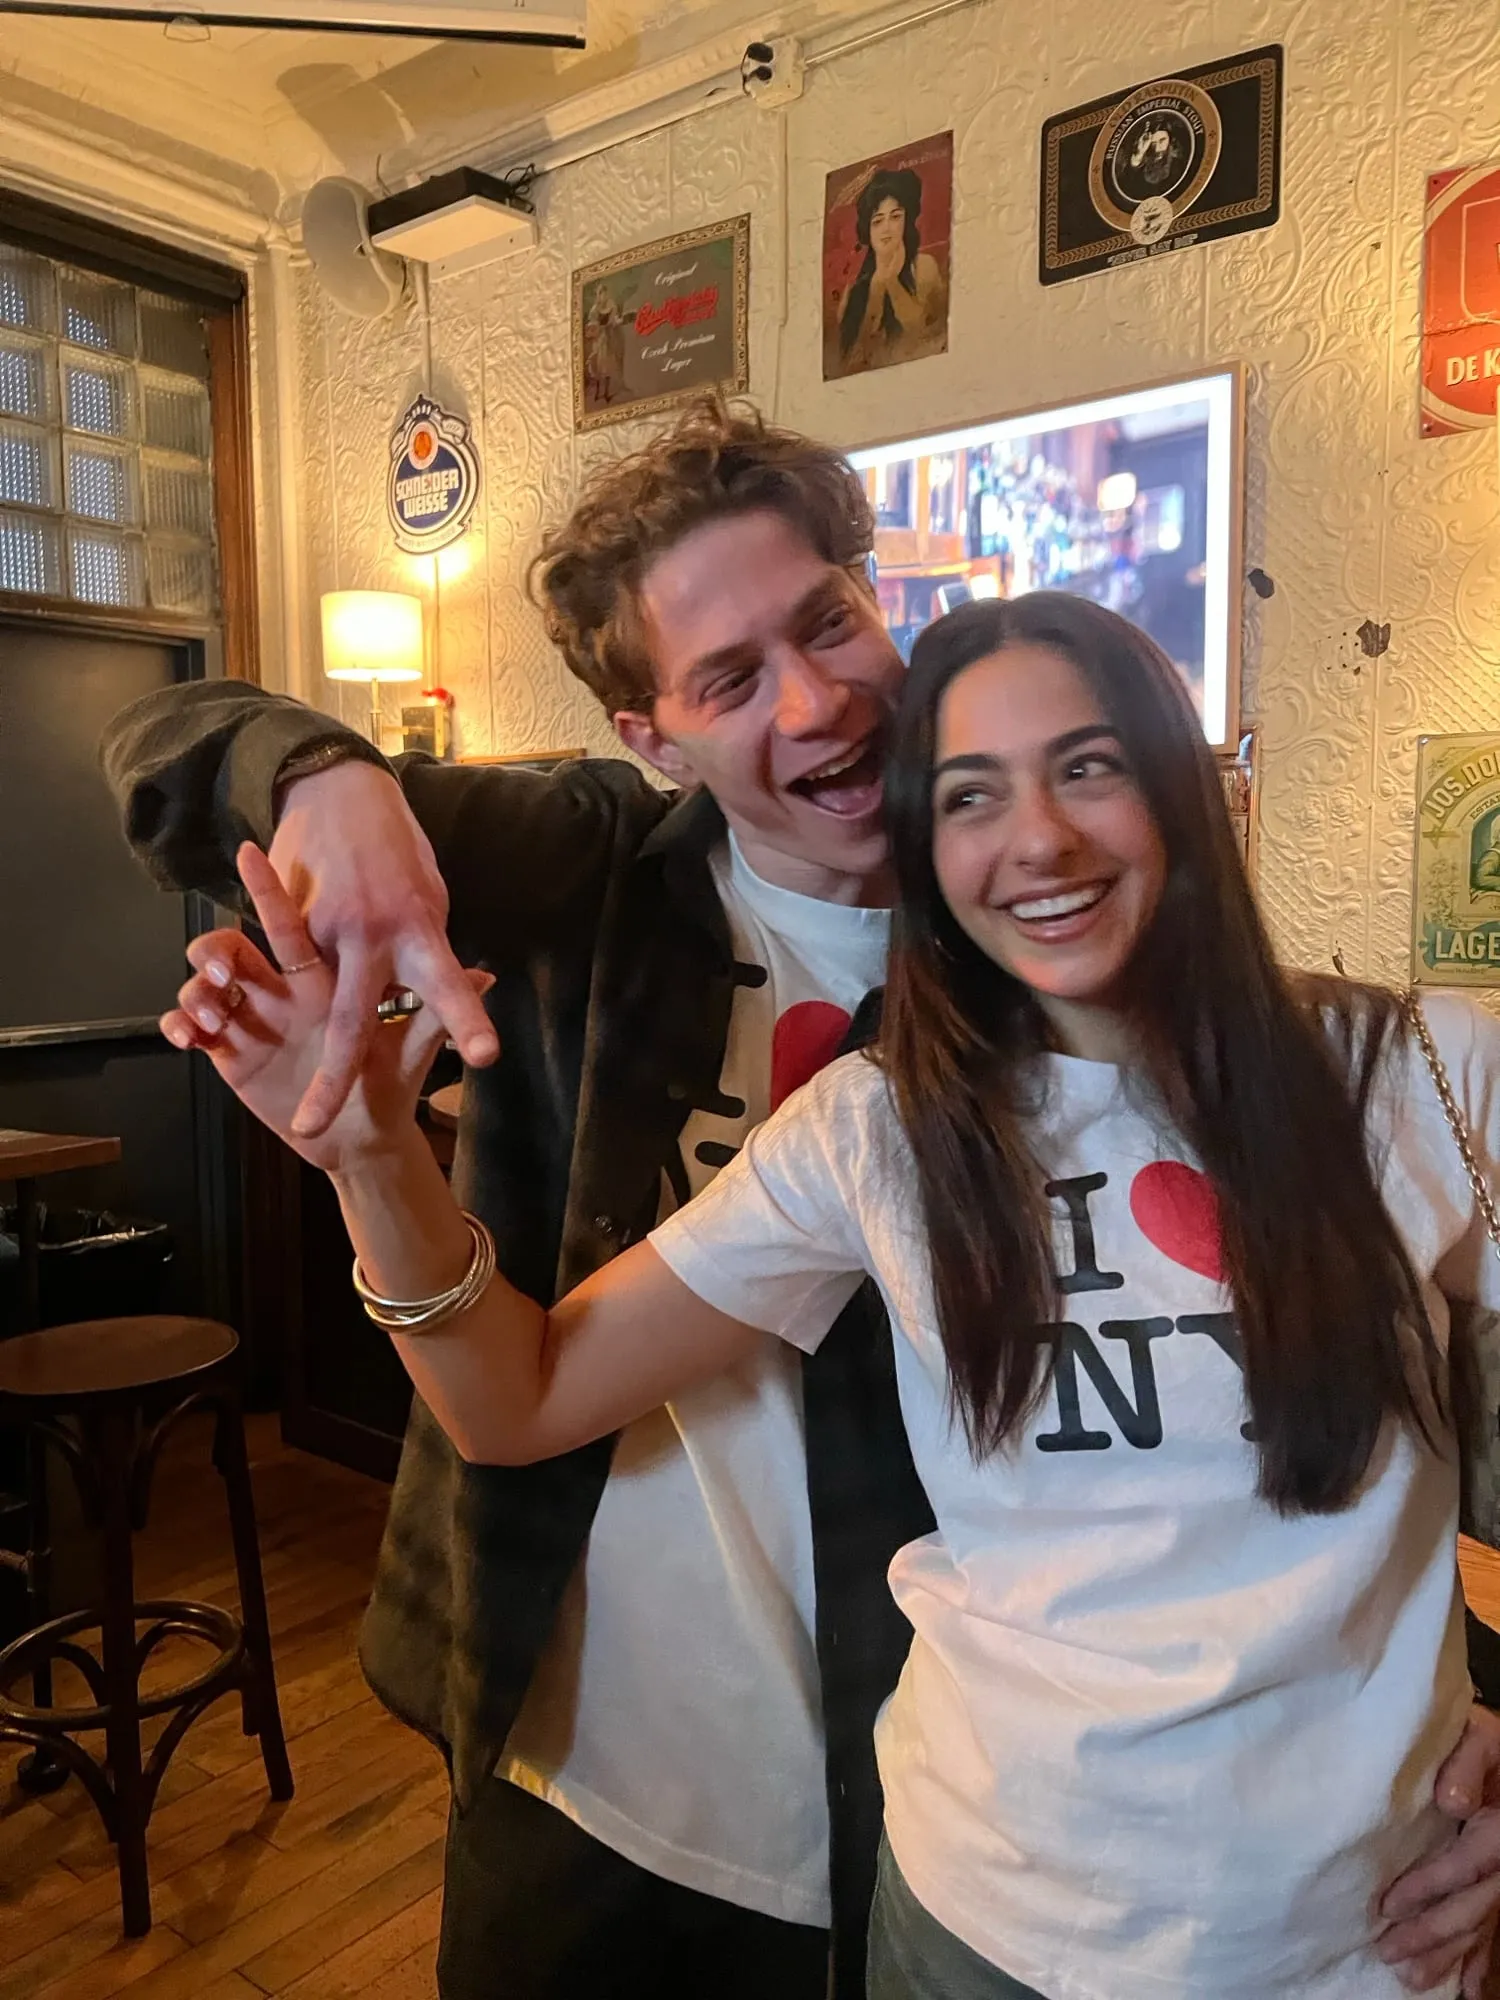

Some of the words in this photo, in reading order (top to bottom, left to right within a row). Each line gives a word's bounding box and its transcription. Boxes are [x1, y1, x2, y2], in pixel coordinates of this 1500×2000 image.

[1106, 115, 1134, 160] RUSSIAN
[1183, 106, 1204, 135] STOUT
[1446, 355, 1479, 386] DE
[396, 467, 459, 502] SCHNEIDER
[403, 489, 449, 519] WEISSE
[1045, 1171, 1125, 1295] I
